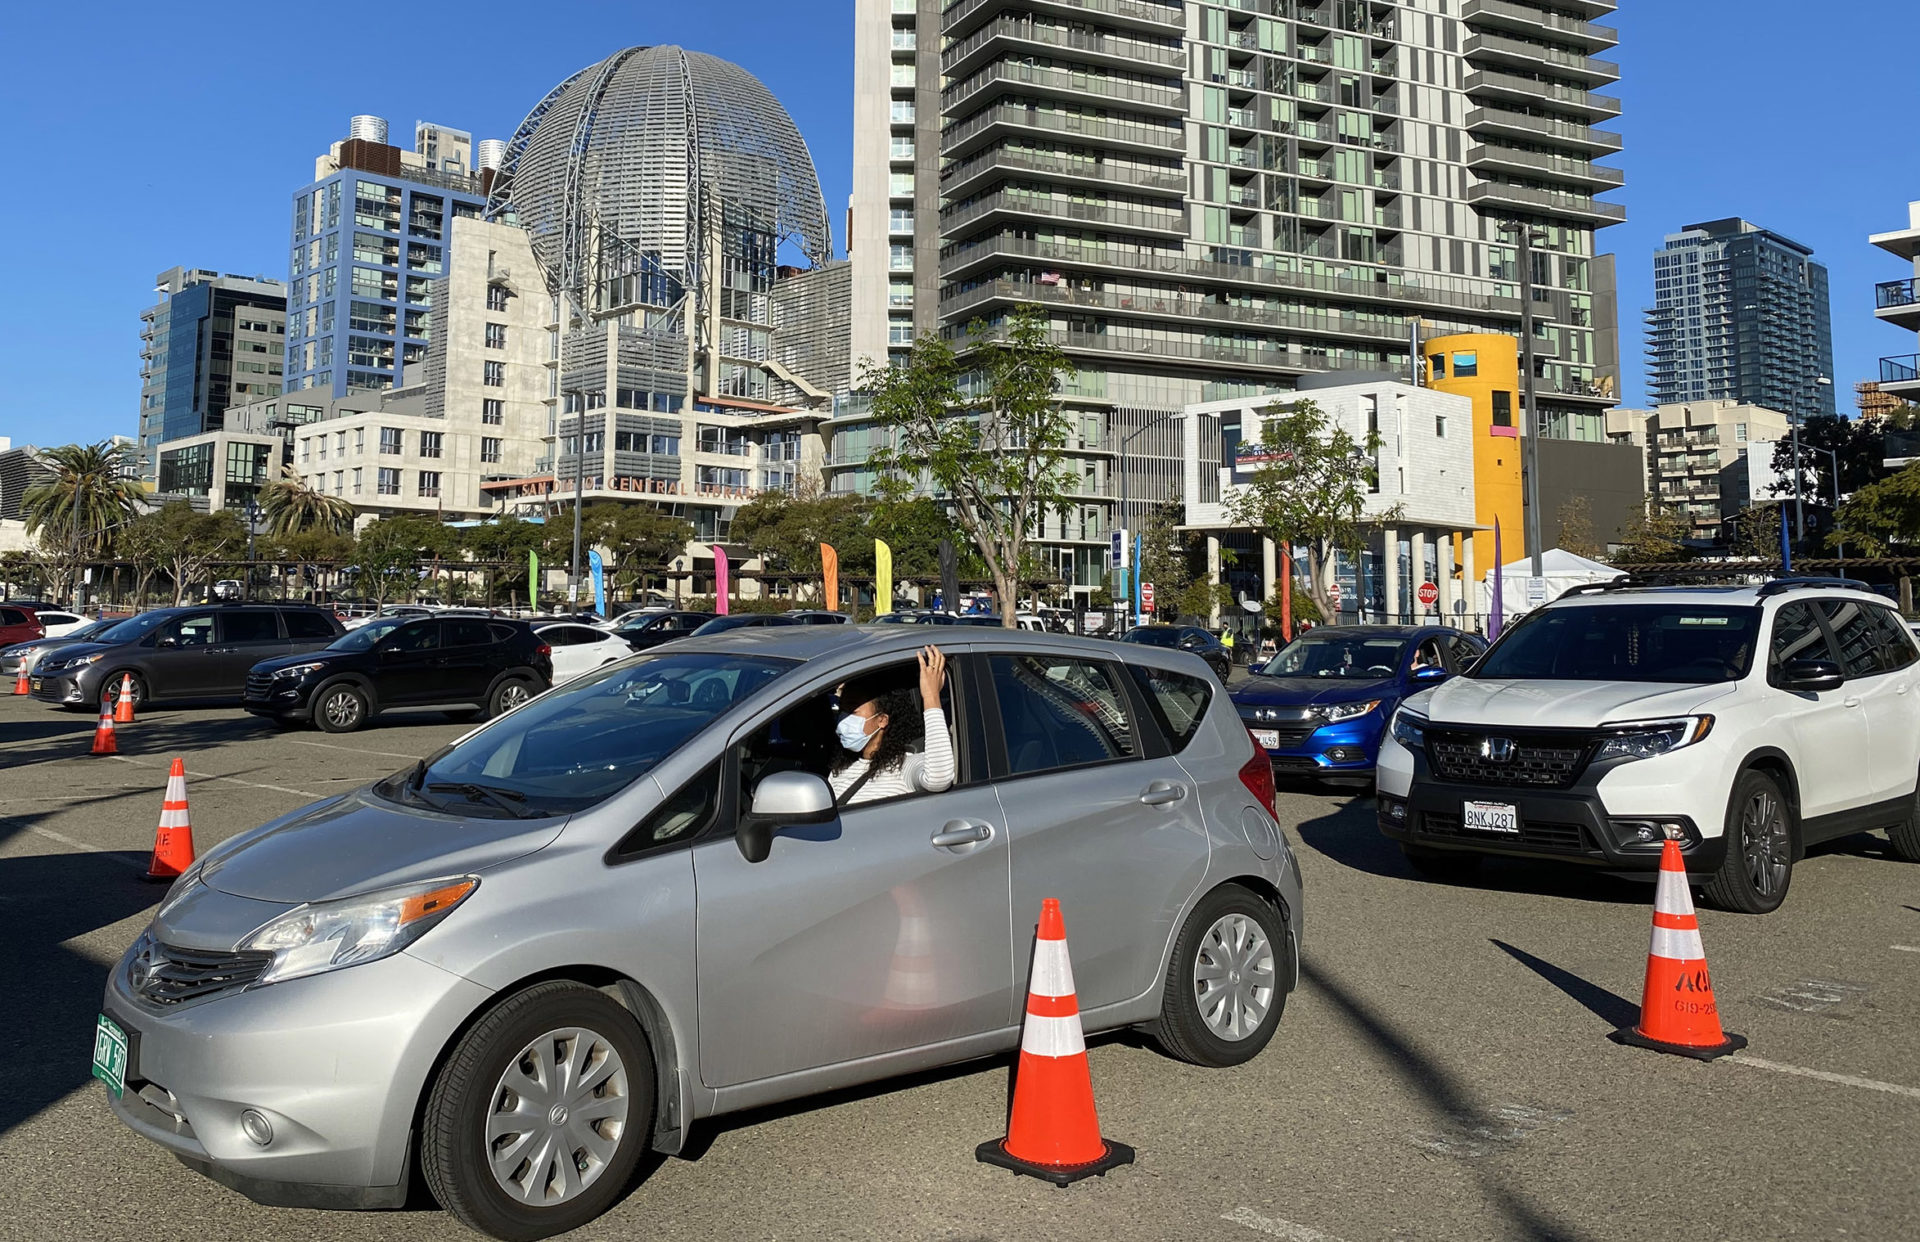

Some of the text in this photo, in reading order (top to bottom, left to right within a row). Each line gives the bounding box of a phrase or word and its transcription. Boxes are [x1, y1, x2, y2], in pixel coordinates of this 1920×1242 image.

[521, 476, 763, 501] SAN DIEO CENTRAL LIBRAR
[1419, 588, 1438, 599] STOP
[1467, 810, 1514, 829] 8NKJ287
[1675, 970, 1711, 992] AC
